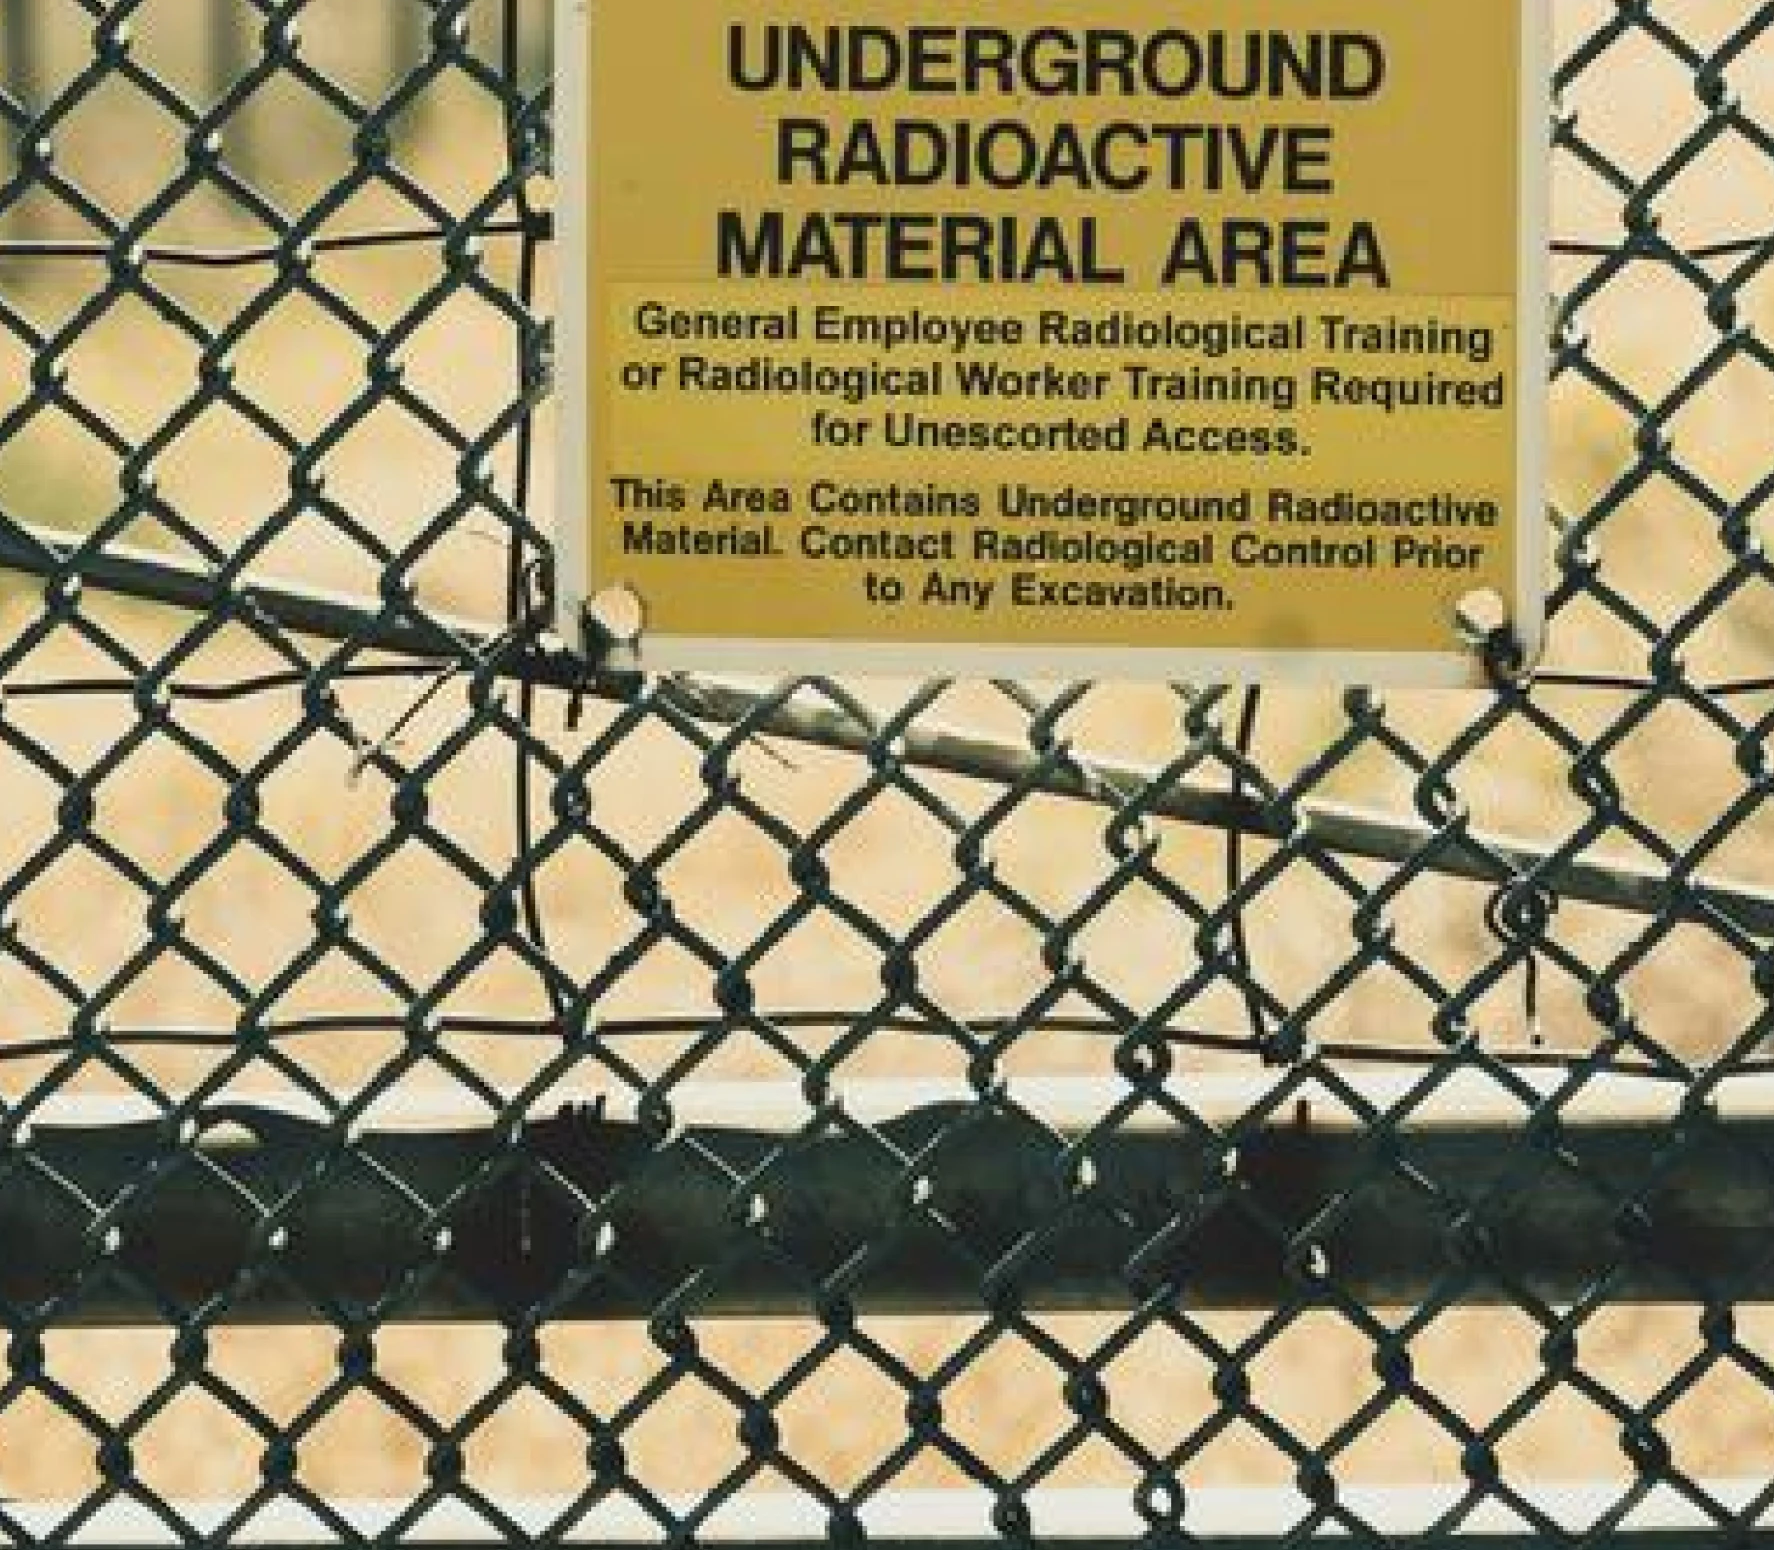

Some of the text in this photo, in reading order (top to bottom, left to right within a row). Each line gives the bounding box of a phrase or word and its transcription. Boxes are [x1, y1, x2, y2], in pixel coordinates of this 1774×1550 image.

[730, 25, 1386, 101] UNDERGROUND
[777, 118, 1335, 195] RADIOACTIVE
[717, 211, 1391, 289] MATERIAL AREA
[637, 300, 1494, 363] General Employee Radiological Training
[623, 356, 1504, 414] or Radiological Worker Training Required
[810, 409, 1312, 457] for Unescorted Access.
[609, 477, 1499, 527] This Area Contains Underground Radioactive
[623, 520, 1485, 573] Material. Contact Radiological Control Prior
[866, 571, 1233, 611] to Any Excavation.
